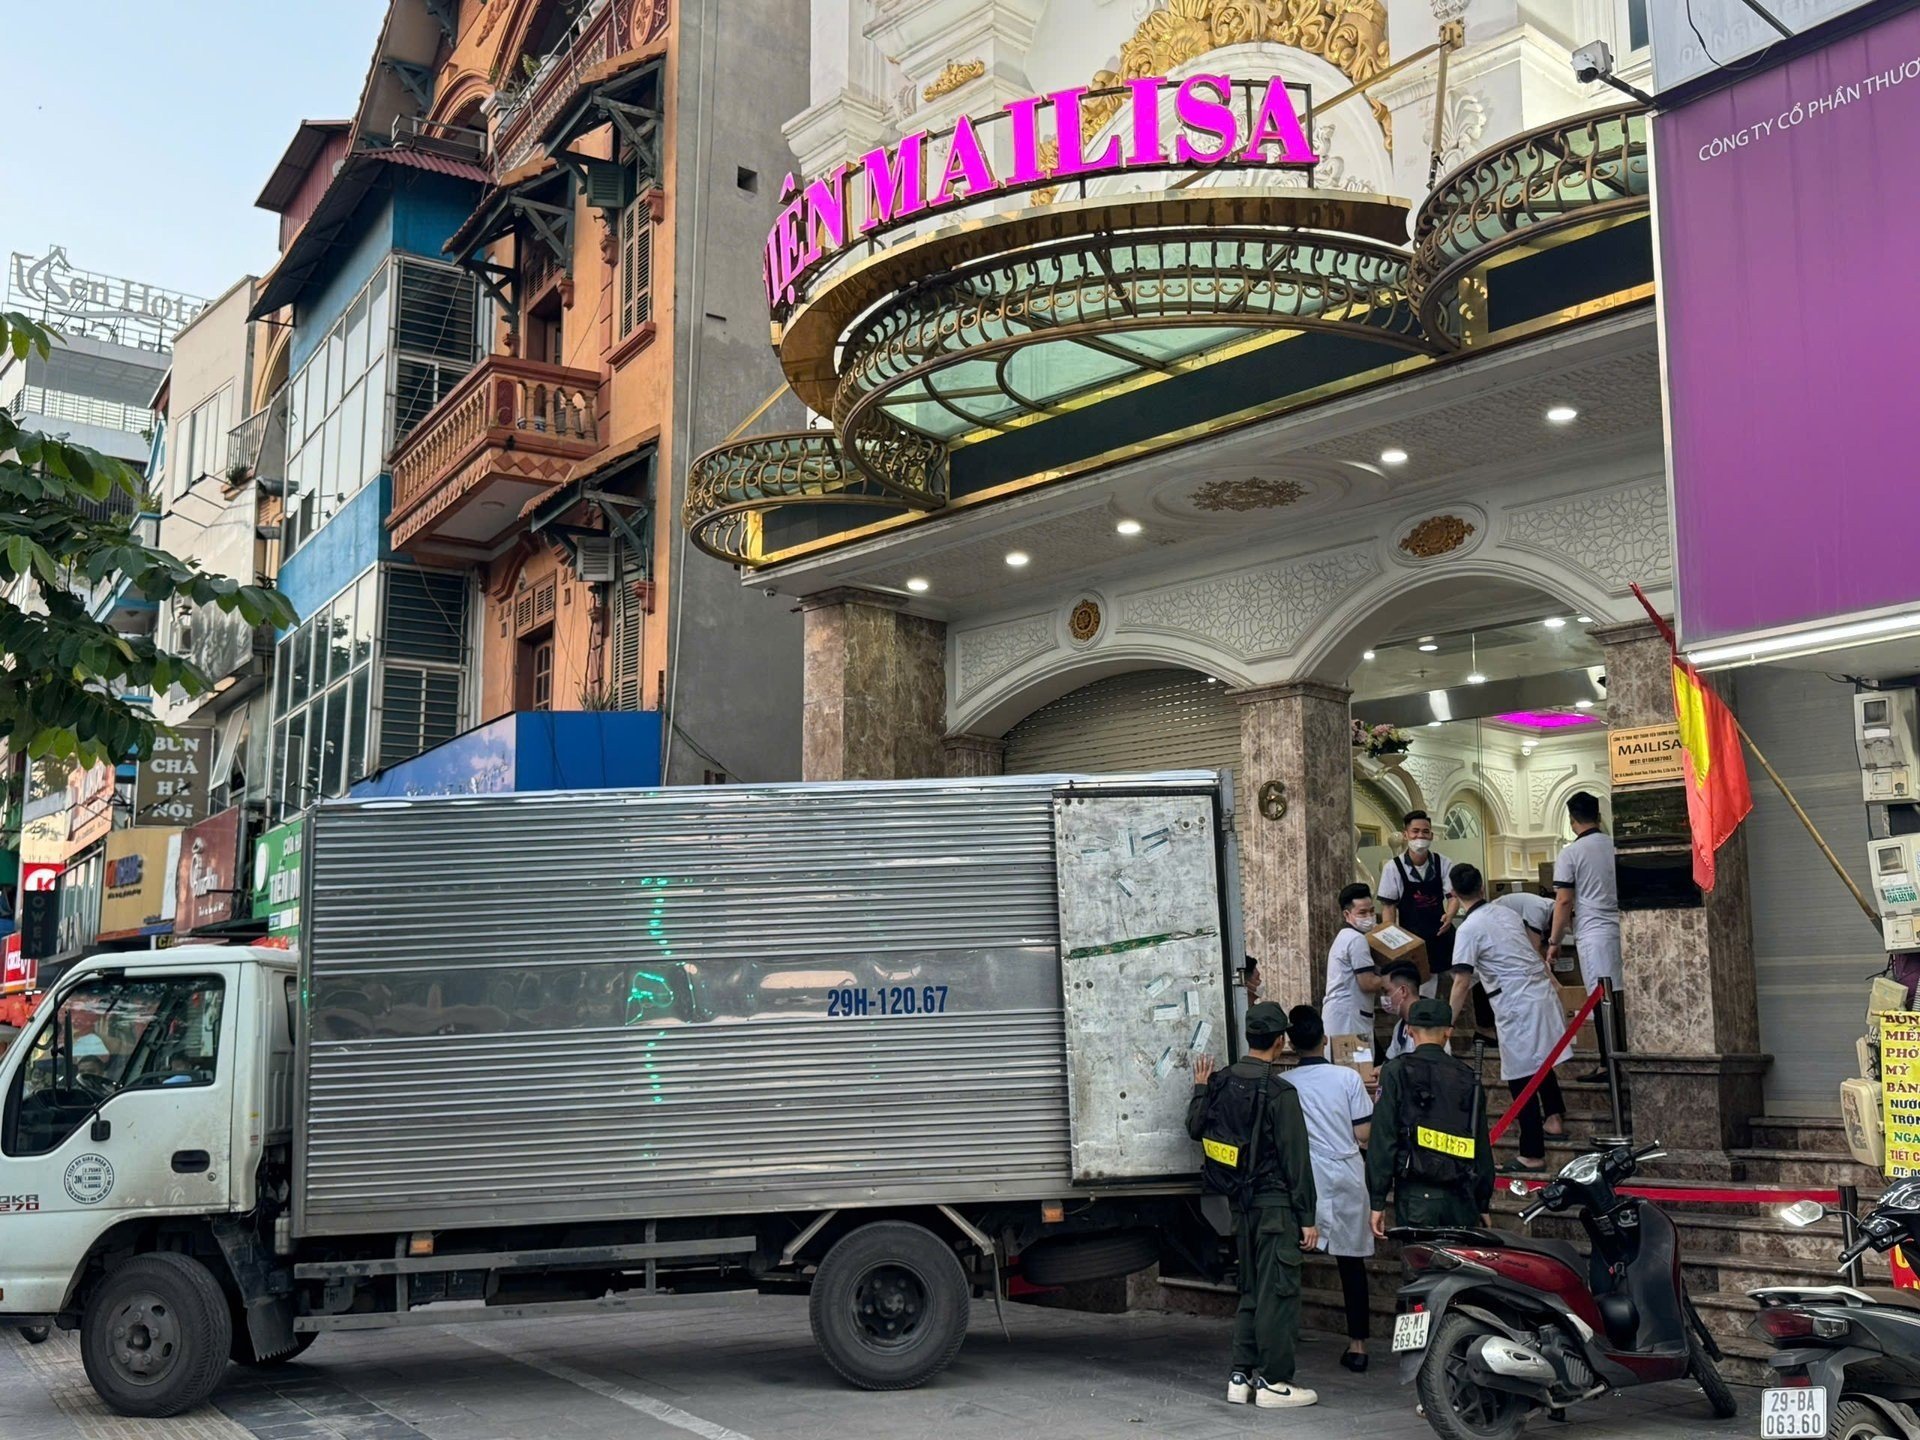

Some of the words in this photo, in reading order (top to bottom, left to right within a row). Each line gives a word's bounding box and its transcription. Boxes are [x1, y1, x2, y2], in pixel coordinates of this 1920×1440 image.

[1698, 129, 1749, 162] CÔNG
[1751, 118, 1774, 140] TY
[1777, 102, 1804, 129] CỔ
[1808, 84, 1861, 119] PHẦN
[763, 172, 847, 308] IỆN
[859, 74, 1320, 232] MAILISA
[1618, 739, 1682, 756] MAILISA
[151, 755, 199, 774] CHẢ
[157, 778, 190, 796] HÀ
[152, 800, 194, 821] NỘI
[1258, 780, 1287, 820] 6
[31, 896, 45, 955] OWEN
[827, 986, 948, 1017] 29H-120.67
[0, 1203, 39, 1212] 270
[1399, 1313, 1424, 1332] 29-M1
[1394, 1330, 1424, 1349] 569.45
[1771, 1391, 1814, 1412] 29-BA
[1767, 1413, 1820, 1434] 063.60
